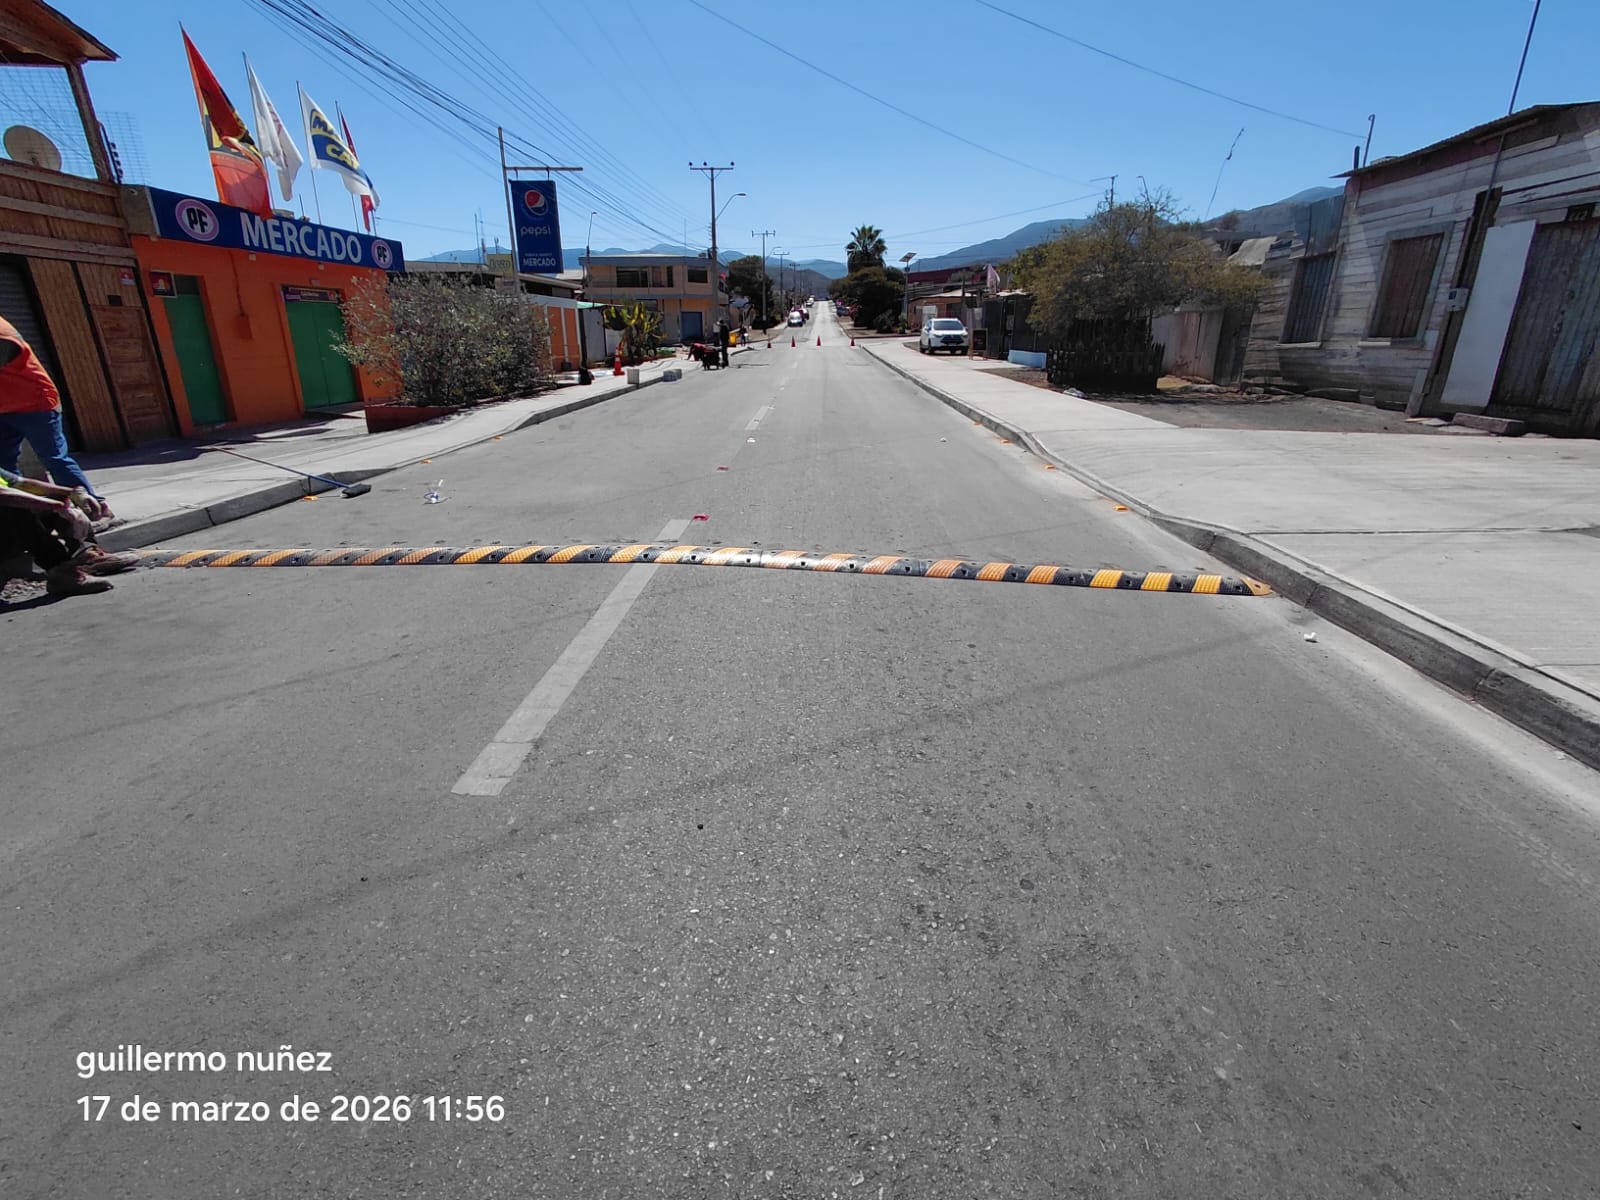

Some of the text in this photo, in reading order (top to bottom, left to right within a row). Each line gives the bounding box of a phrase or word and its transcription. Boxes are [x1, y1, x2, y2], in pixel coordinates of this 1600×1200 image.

[185, 207, 209, 233] PF
[239, 211, 363, 264] MERCADO
[520, 224, 551, 237] pepsi
[523, 257, 556, 267] MERCADO
